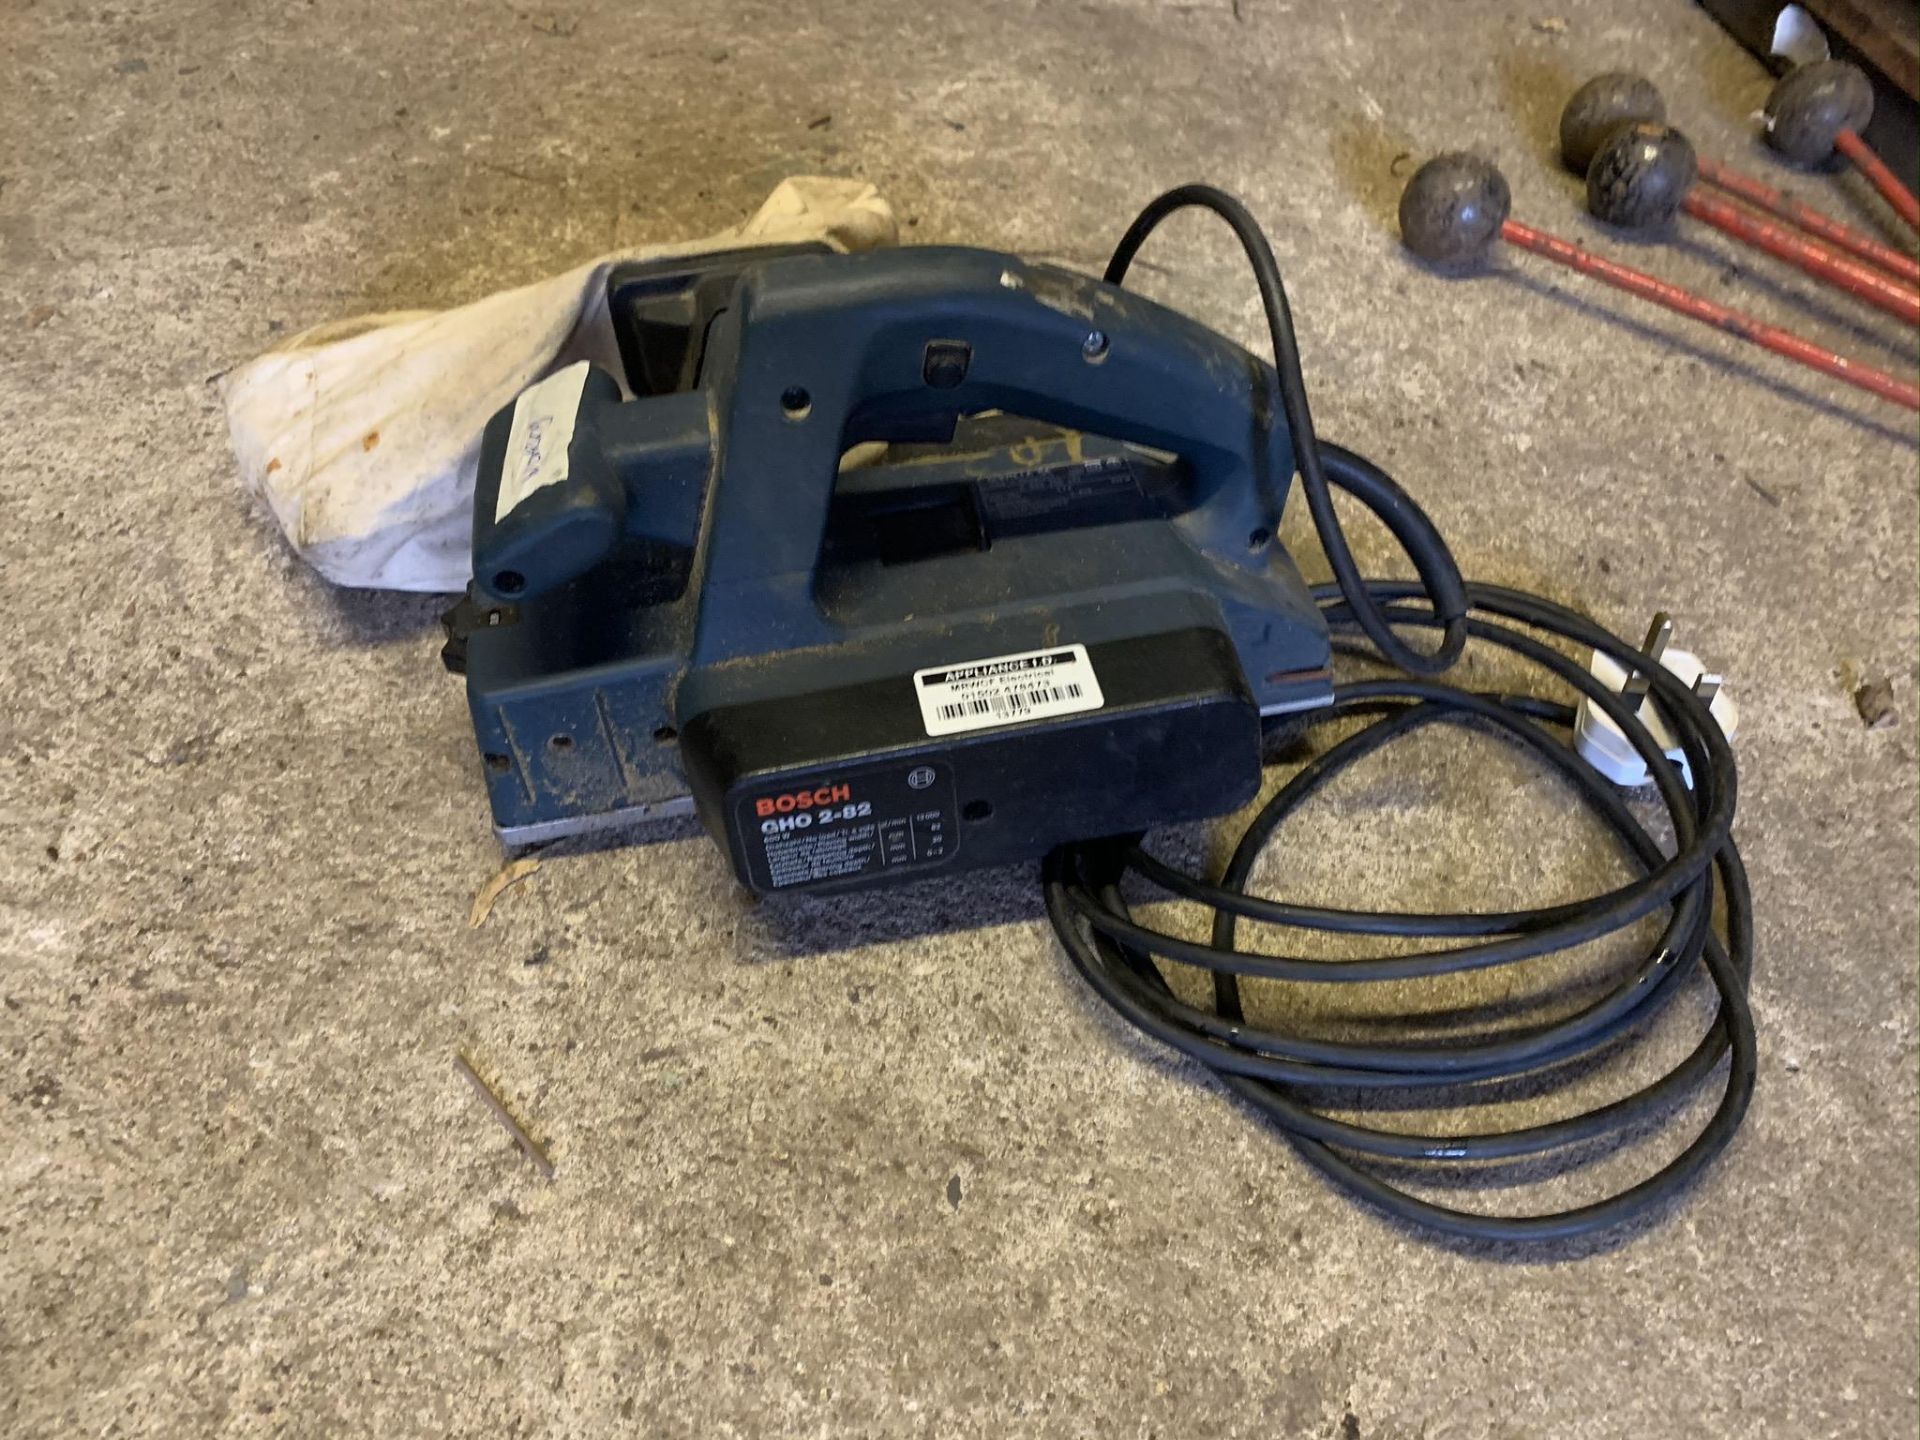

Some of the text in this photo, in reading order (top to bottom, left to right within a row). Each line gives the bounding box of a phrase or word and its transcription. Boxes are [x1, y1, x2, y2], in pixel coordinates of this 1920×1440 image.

[945, 659, 1030, 683] APPLIANCE
[999, 668, 1054, 687] Electrical
[756, 783, 851, 817] BOSCH
[818, 801, 872, 824] 2-82
